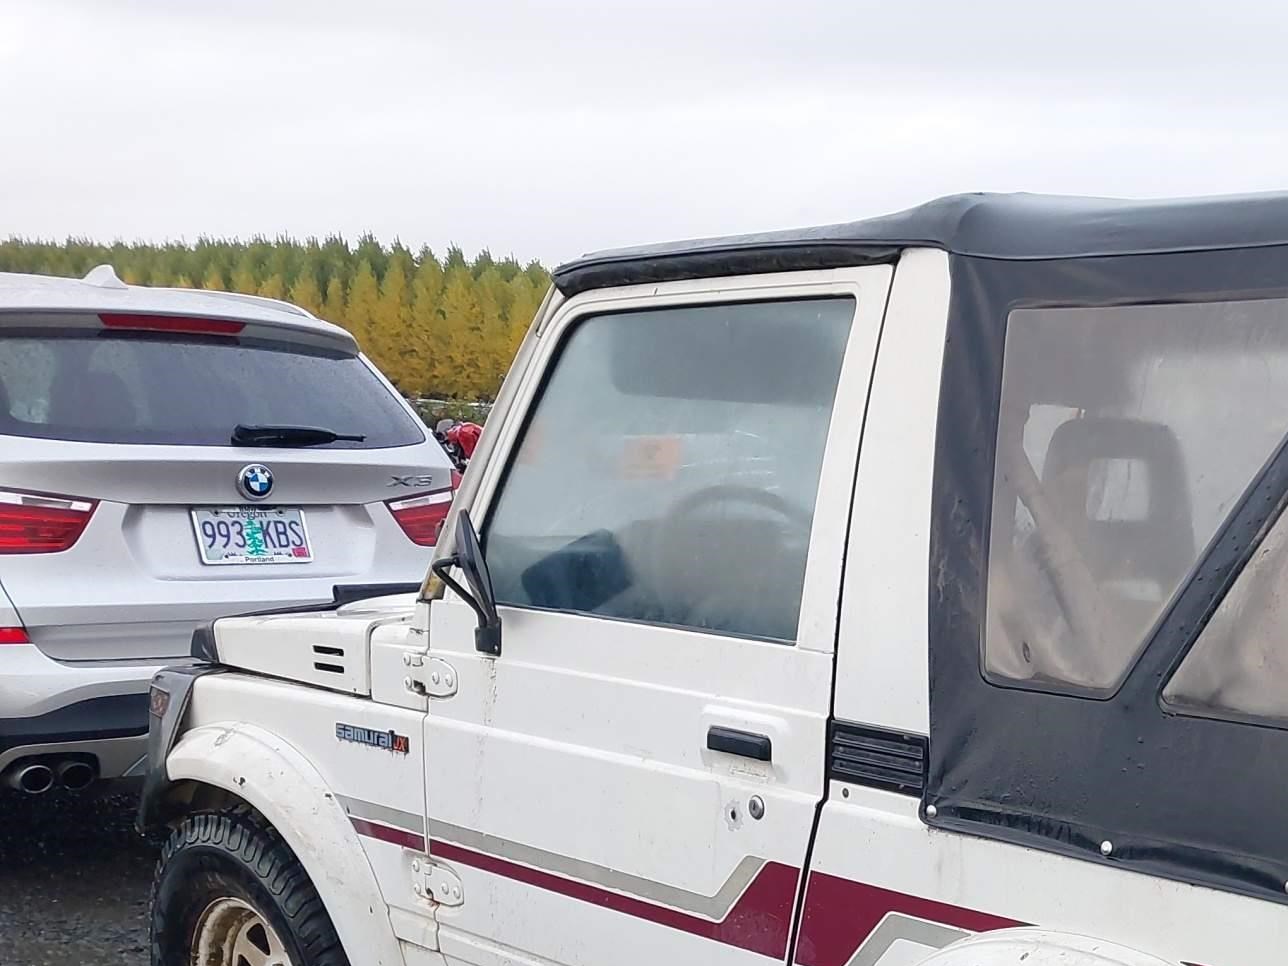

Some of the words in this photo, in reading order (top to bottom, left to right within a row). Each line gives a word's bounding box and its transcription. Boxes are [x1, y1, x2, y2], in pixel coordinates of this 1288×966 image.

[385, 474, 432, 488] X3
[201, 519, 248, 549] 993
[259, 518, 305, 549] KBS
